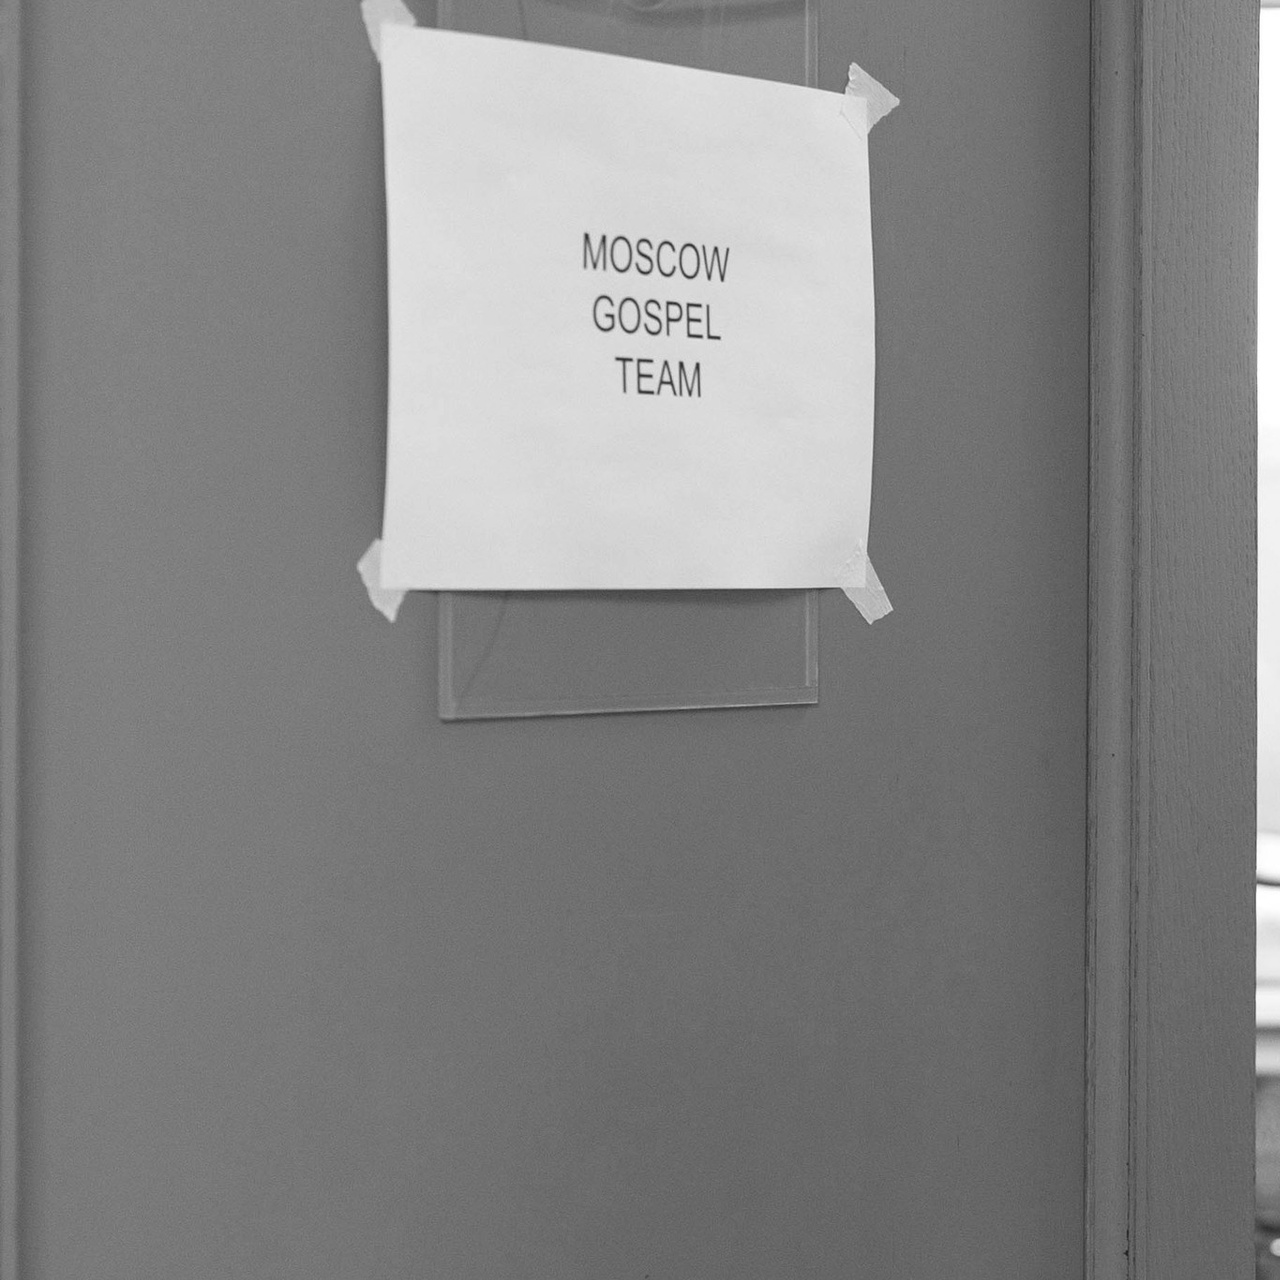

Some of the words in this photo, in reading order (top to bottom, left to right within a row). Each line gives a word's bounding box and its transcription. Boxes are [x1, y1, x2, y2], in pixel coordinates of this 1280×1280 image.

[583, 233, 730, 282] MOSCOW
[593, 295, 721, 340] GOSPEL
[615, 357, 702, 398] TEAM
